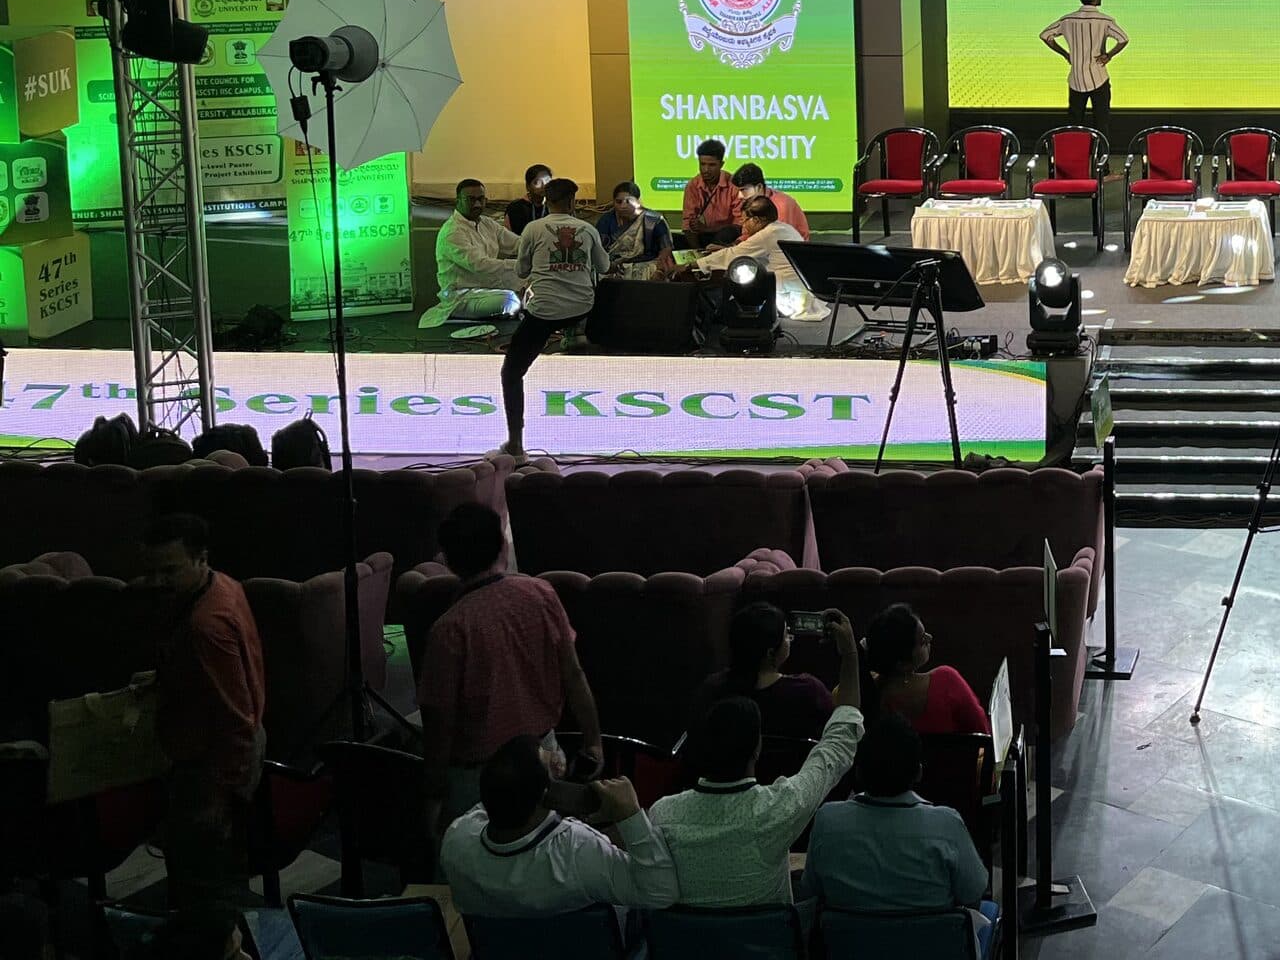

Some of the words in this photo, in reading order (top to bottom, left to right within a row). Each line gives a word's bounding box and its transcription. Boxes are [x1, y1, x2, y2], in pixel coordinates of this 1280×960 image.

[24, 67, 71, 102] #SUK
[241, 76, 255, 84] FOR
[231, 107, 276, 116] KALABURAG
[660, 93, 830, 121] SHARNBASVA
[224, 144, 274, 157] KSCST
[675, 134, 817, 159] UNVERSITY
[288, 229, 313, 242] 47th
[315, 228, 356, 240] Sees
[358, 224, 406, 239] KSCST
[38, 251, 78, 283] 47th
[39, 278, 79, 303] Series
[39, 292, 81, 320] KSCST
[2, 382, 137, 410] 7th
[181, 385, 500, 417] Series
[539, 389, 873, 422] KSCST
